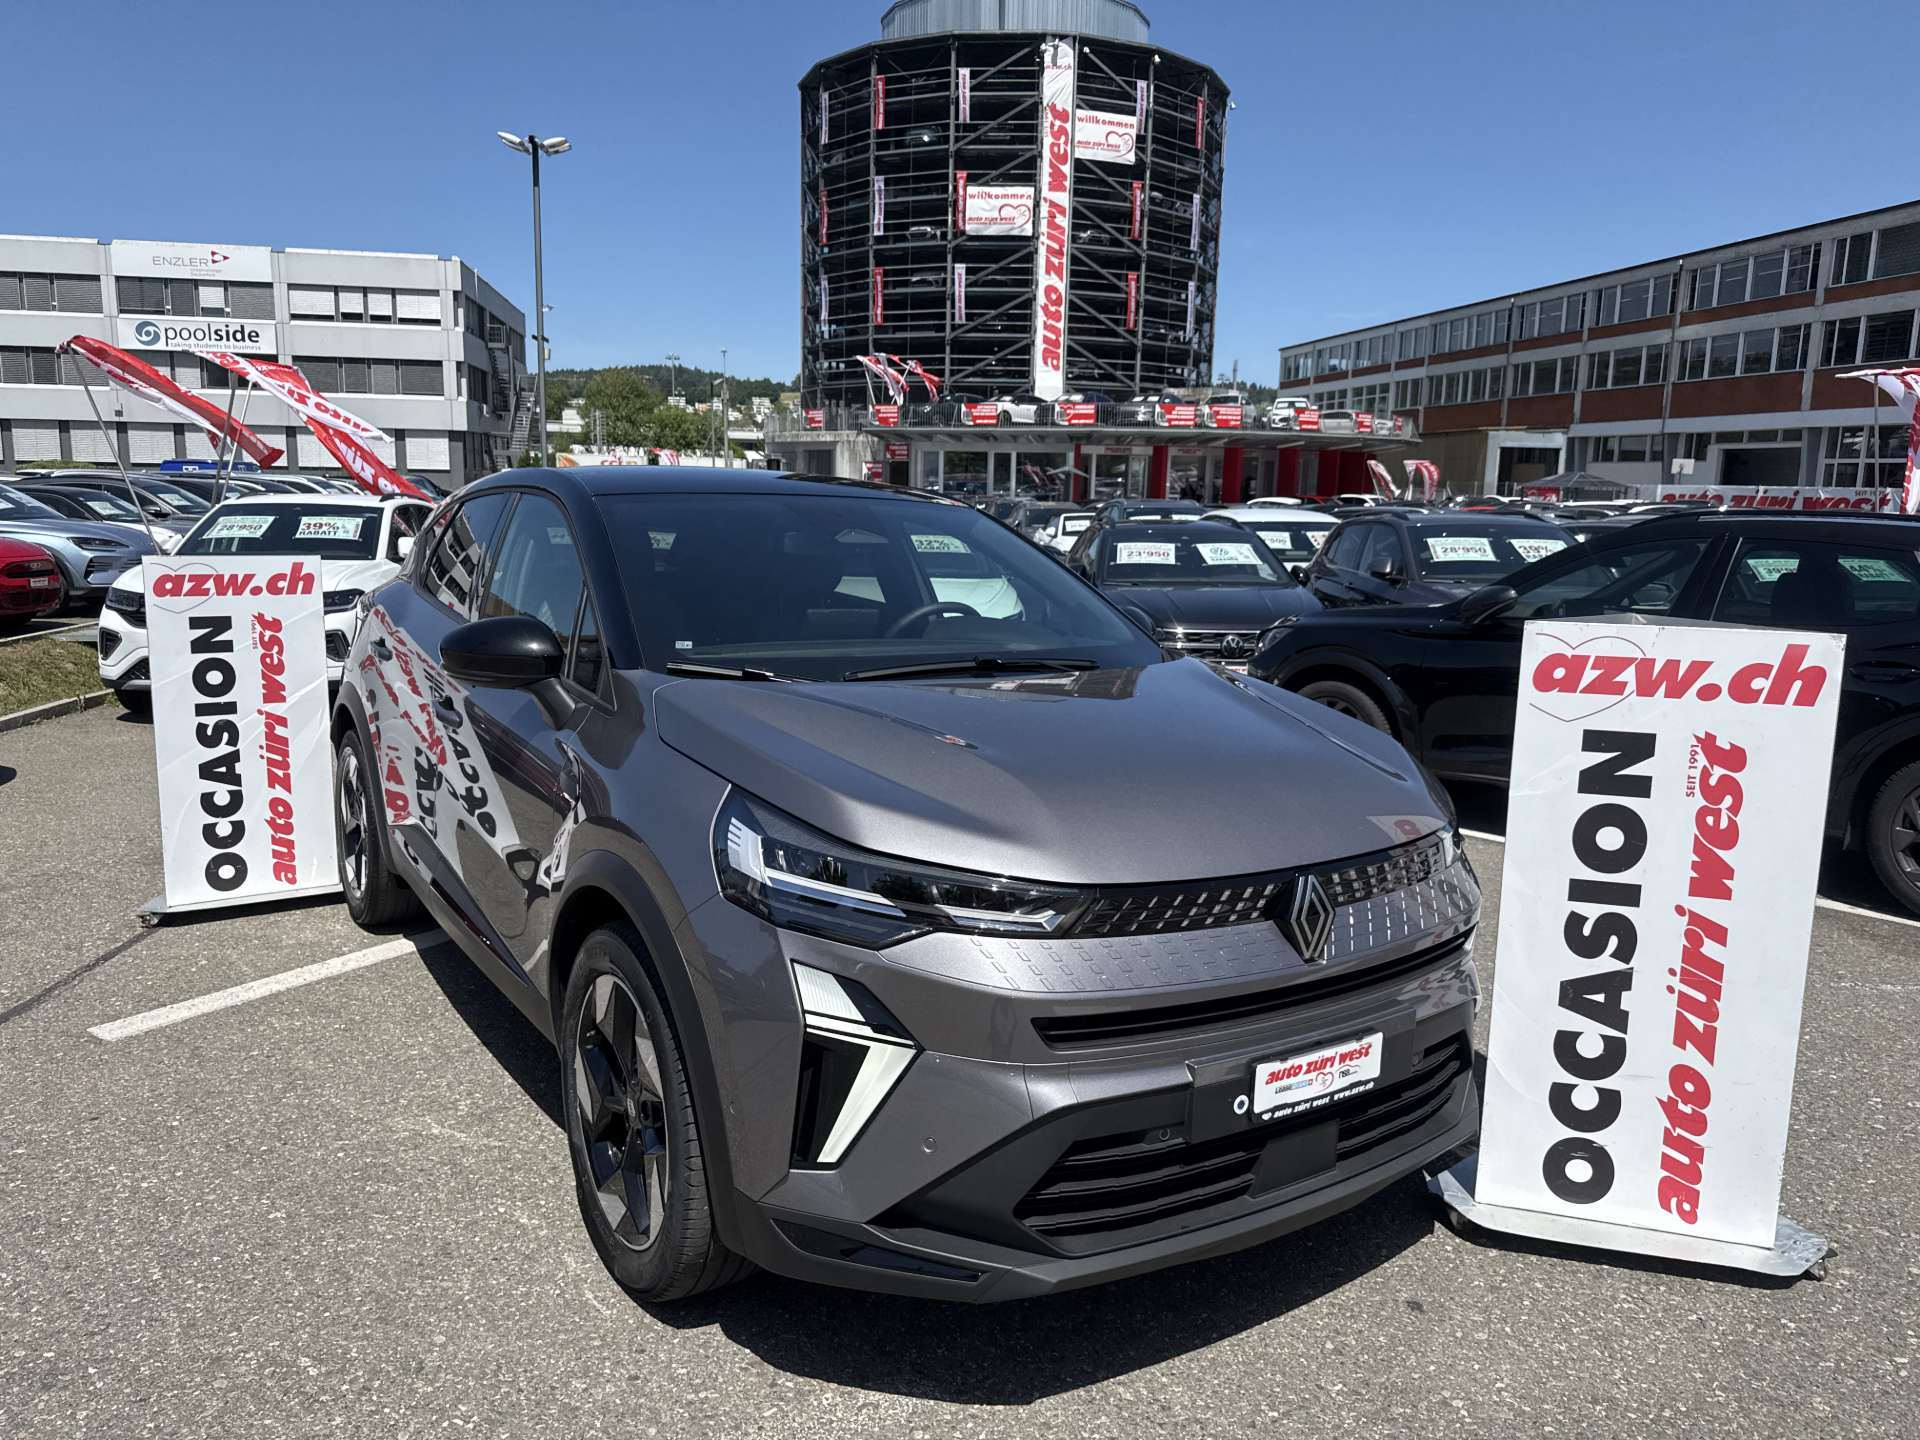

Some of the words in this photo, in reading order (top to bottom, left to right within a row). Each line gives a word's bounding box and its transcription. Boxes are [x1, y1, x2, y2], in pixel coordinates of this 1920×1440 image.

[1048, 101, 1070, 192] west
[1076, 114, 1135, 129] willkommen
[968, 190, 1032, 200] willkommen
[152, 255, 209, 268] ENZLER
[1039, 196, 1067, 283] züri
[164, 323, 260, 347] poolside
[1040, 285, 1063, 371] auto
[301, 522, 340, 531] 39%
[152, 562, 316, 598] azw.ch
[251, 612, 287, 704] west
[1532, 643, 1828, 707] azw.ch
[188, 615, 249, 892] OCCASION
[256, 708, 293, 795] züri
[1685, 774, 1697, 798] SEIT
[1688, 744, 1700, 771] 1991
[264, 796, 298, 886] auto
[1688, 731, 1748, 901] west
[1542, 729, 1657, 1205] OCCASION
[1665, 904, 1729, 1067] züri
[1265, 1062, 1303, 1086] auto
[1303, 1052, 1338, 1075] züri
[1338, 1042, 1373, 1066] west
[1273, 1107, 1292, 1119] auto
[1656, 1063, 1713, 1225] auto
